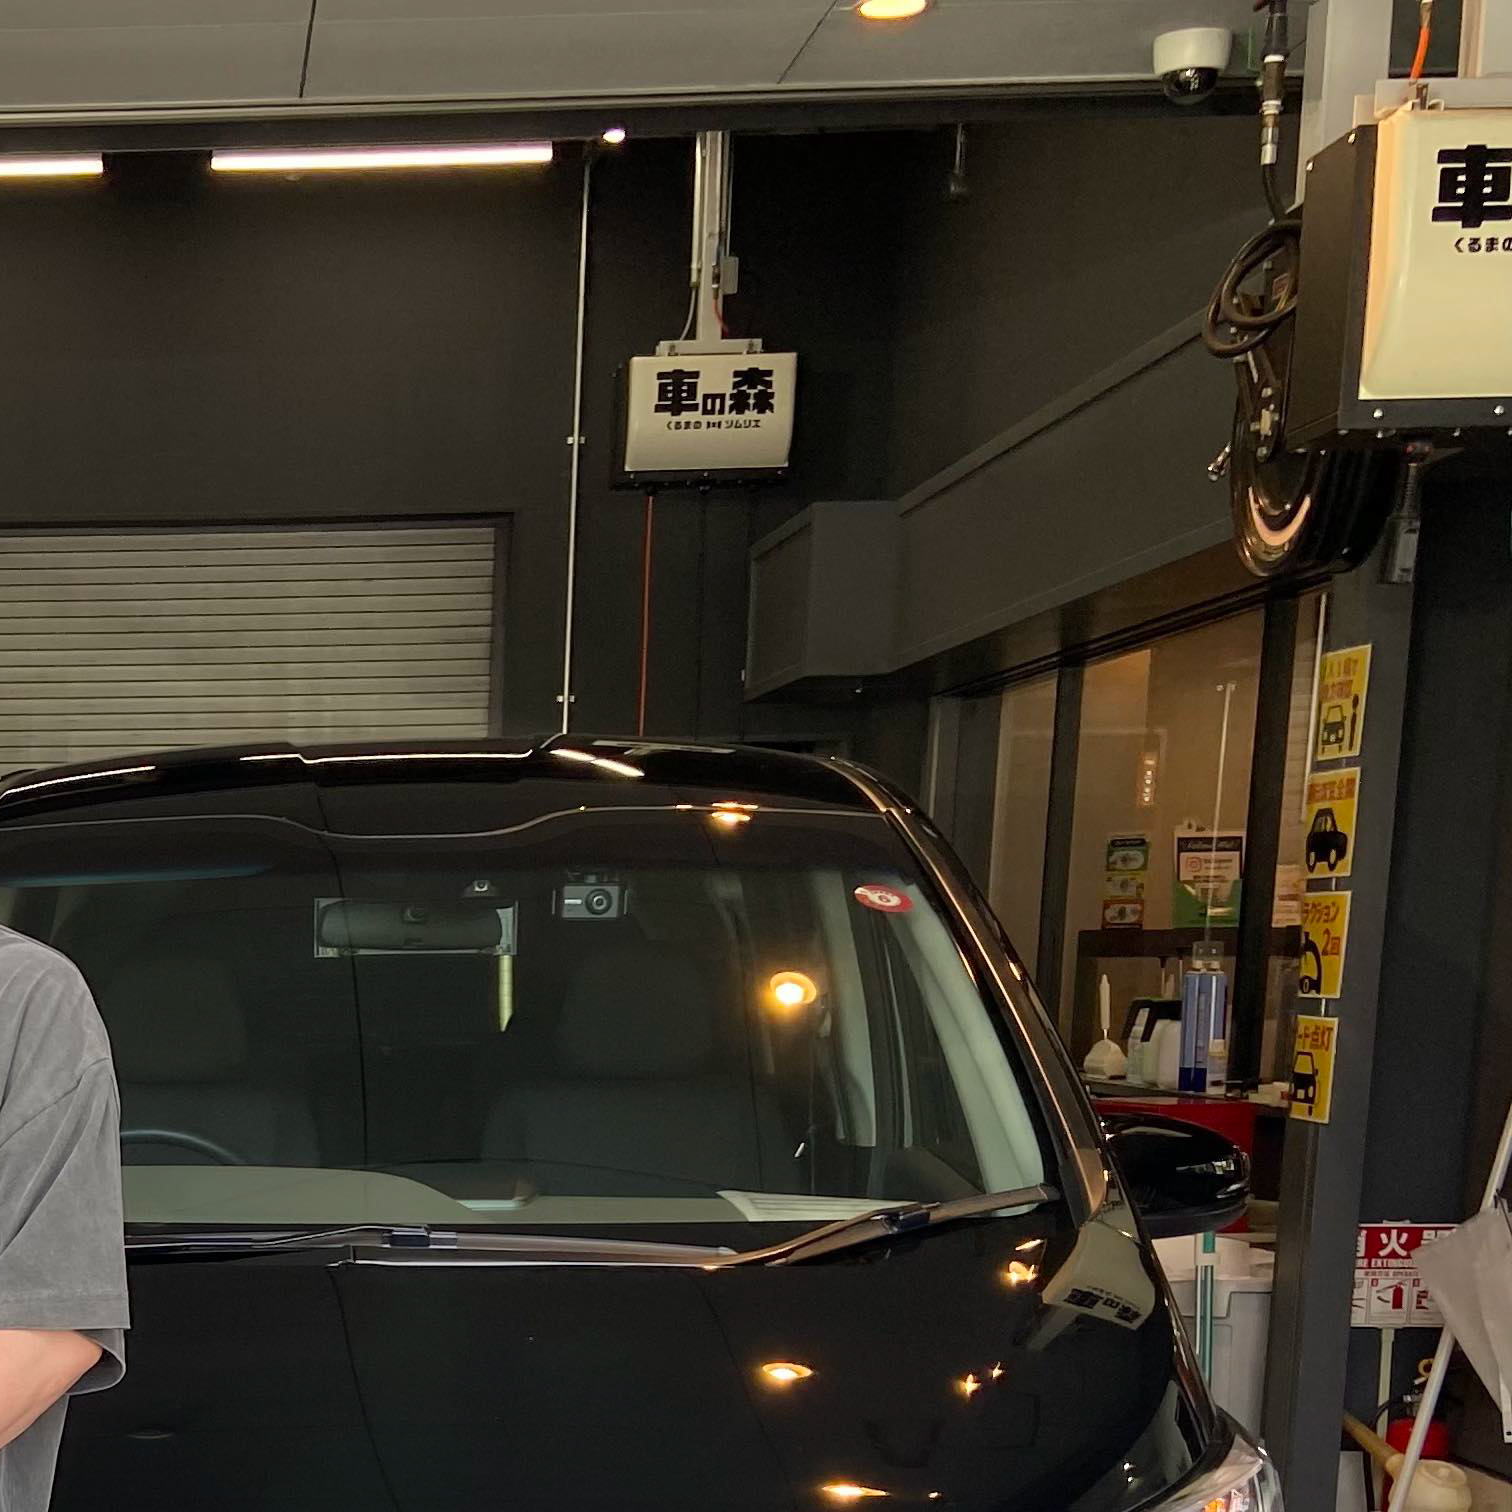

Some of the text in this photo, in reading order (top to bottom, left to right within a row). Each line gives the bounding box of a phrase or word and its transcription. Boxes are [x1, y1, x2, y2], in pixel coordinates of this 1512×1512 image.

[654, 367, 775, 416] 車の森
[666, 419, 761, 430] くるまの ソムリエ
